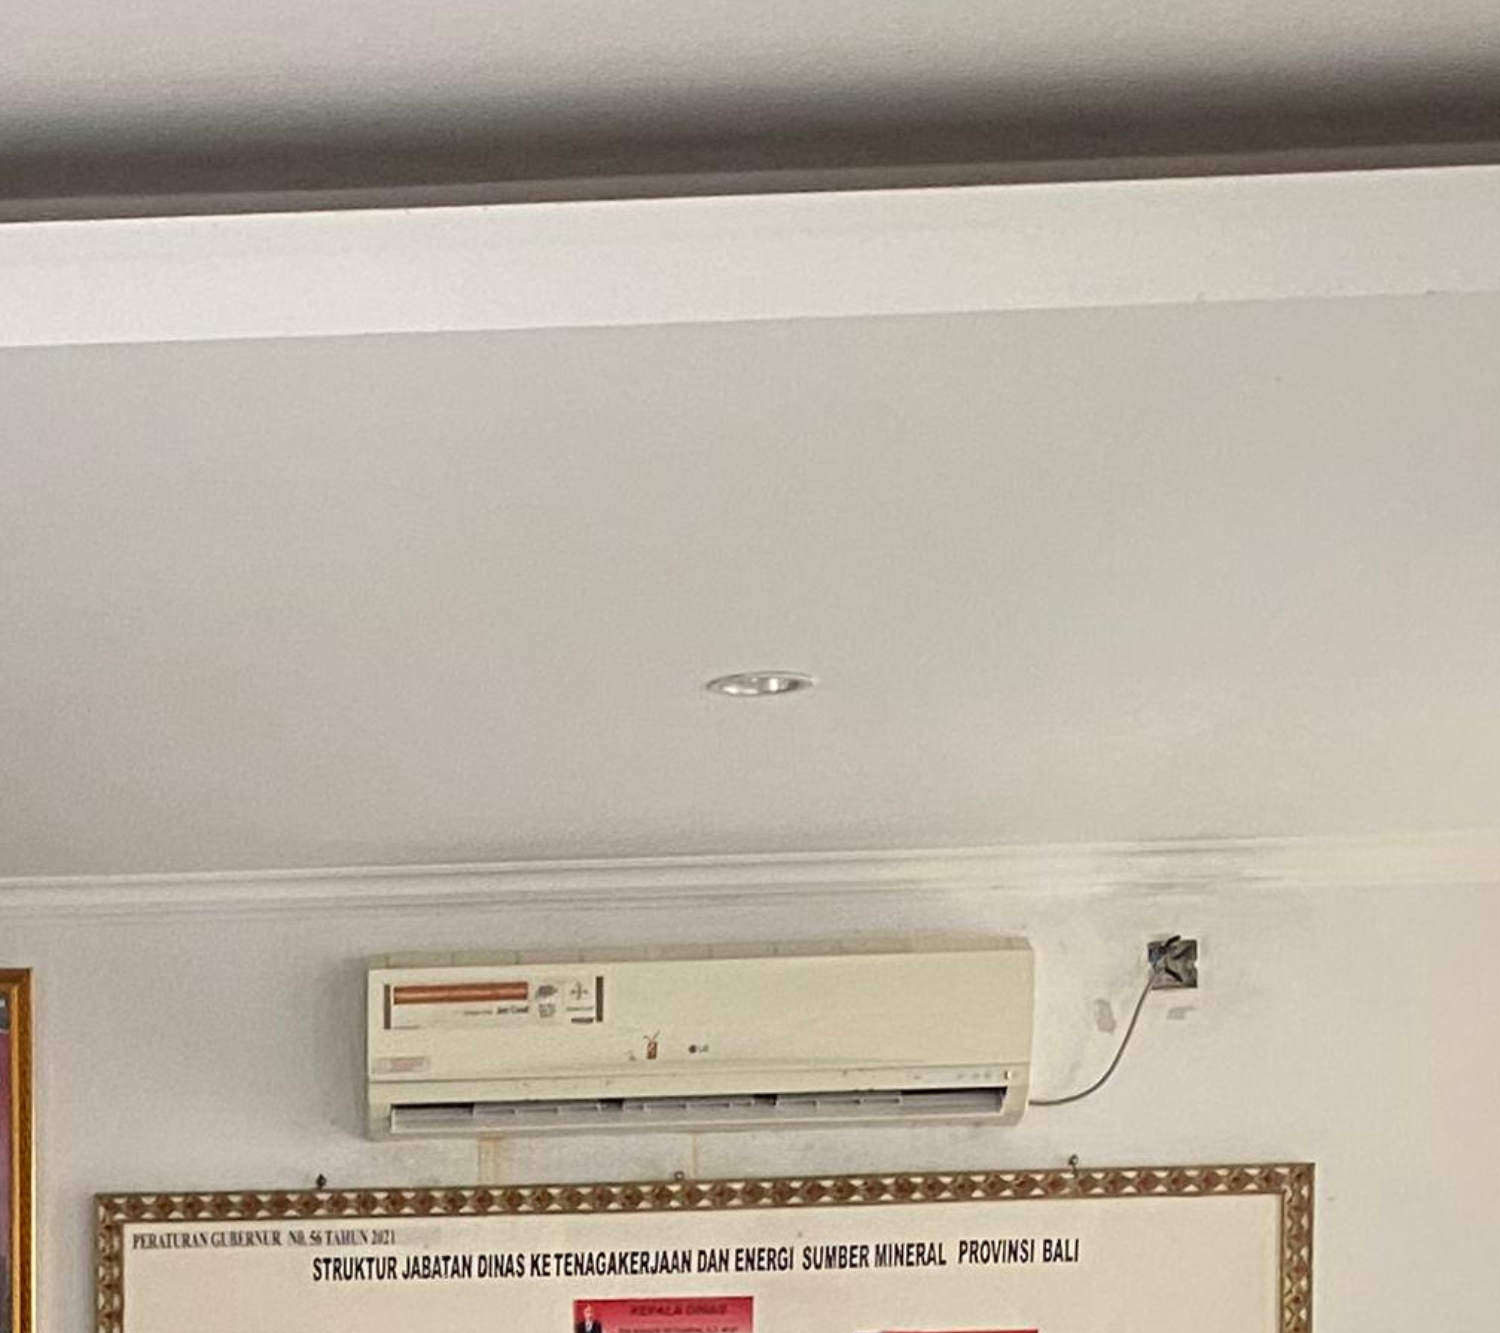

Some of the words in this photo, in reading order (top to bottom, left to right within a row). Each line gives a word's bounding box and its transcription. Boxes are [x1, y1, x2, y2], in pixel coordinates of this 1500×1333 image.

[131, 1232, 208, 1250] PERATURAN
[210, 1230, 282, 1249] GUBERNUR
[309, 1230, 323, 1247] 56
[325, 1229, 369, 1247] TAHUN
[312, 1256, 398, 1282] STRUKTUR
[402, 1255, 473, 1280] JABATAN
[477, 1253, 526, 1278] DINAS
[697, 1249, 730, 1273] DAN
[735, 1246, 795, 1272] ENERGI
[802, 1244, 870, 1270] SUMBER
[874, 1243, 947, 1268] MINERAL
[958, 1239, 1036, 1265] PROVINSI
[1042, 1238, 1080, 1263] BALI
